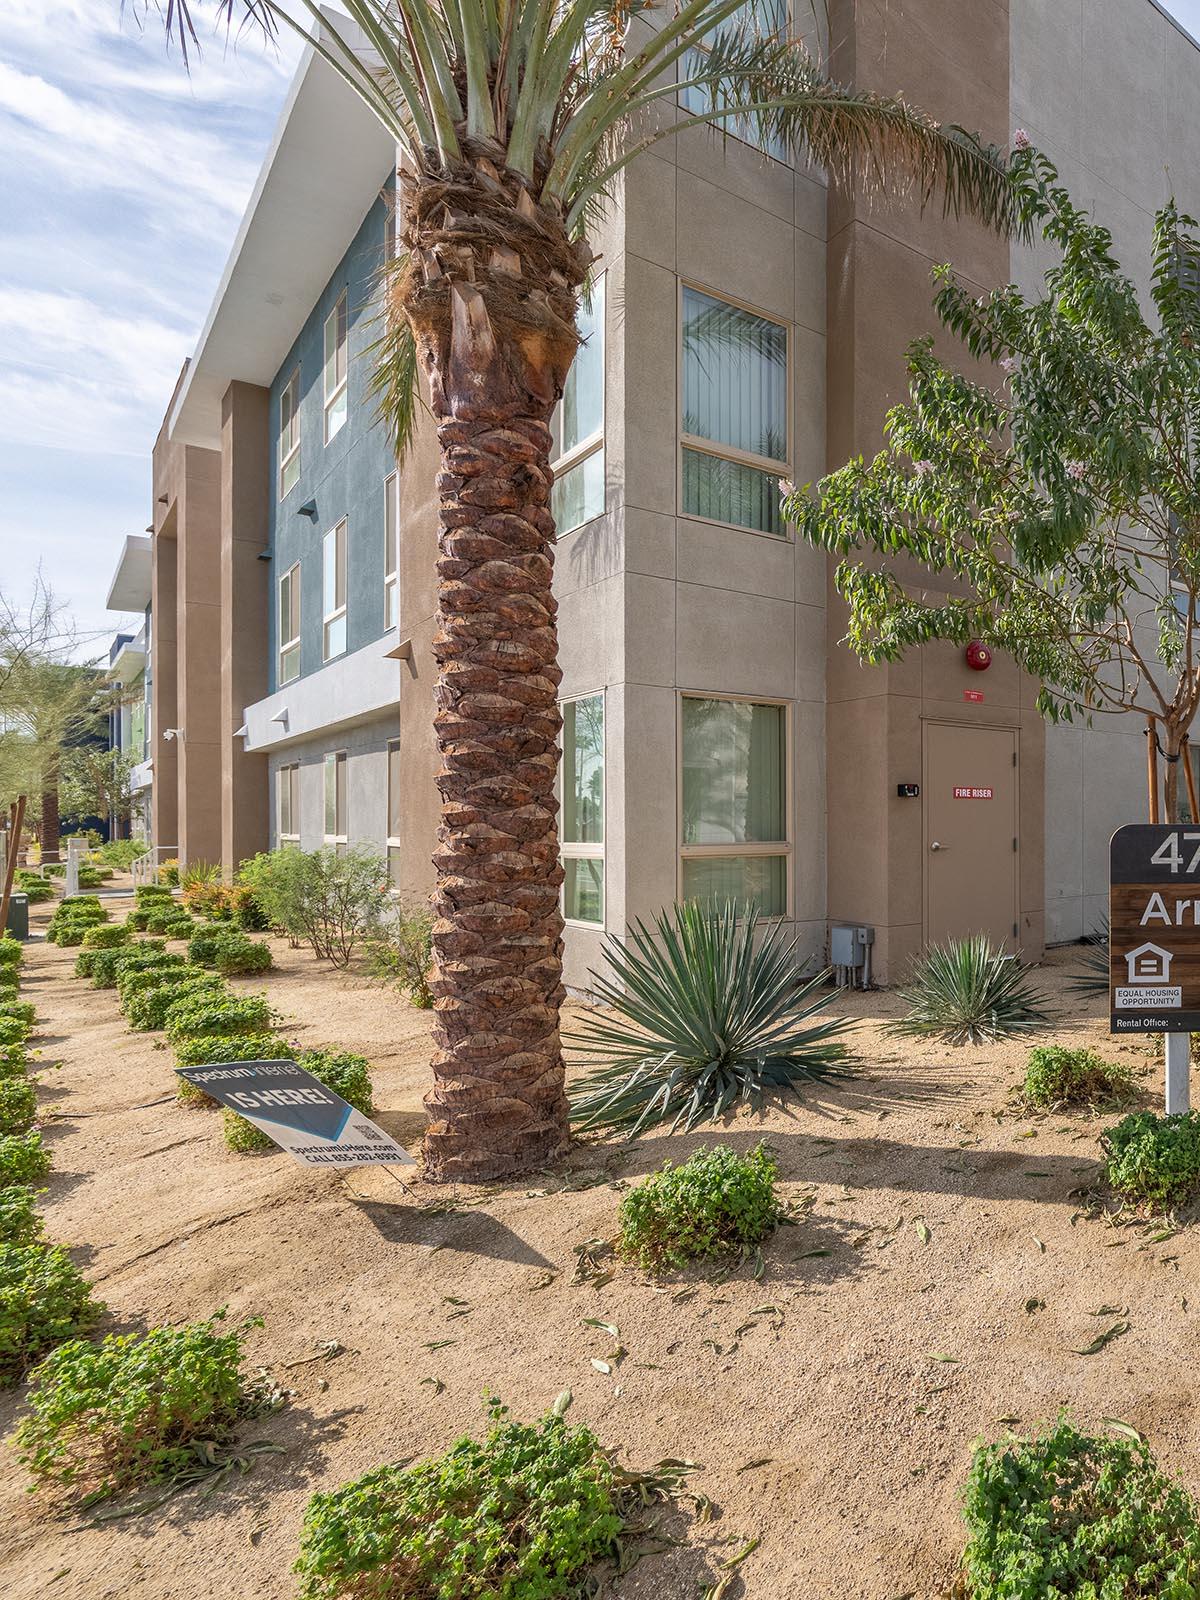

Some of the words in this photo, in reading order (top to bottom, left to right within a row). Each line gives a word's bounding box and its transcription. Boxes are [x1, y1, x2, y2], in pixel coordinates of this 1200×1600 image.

[955, 788, 971, 797] FIRE
[972, 789, 992, 798] RISER
[1117, 989, 1144, 998] EQUAL
[1145, 989, 1180, 998] HOUSING
[1121, 997, 1176, 1006] OPPORTUNITY
[1116, 1019, 1142, 1028] Rental
[1143, 1018, 1169, 1028] Office:
[182, 1068, 253, 1083] Spectrum
[225, 1092, 260, 1109] IS
[259, 1089, 334, 1107] HERE!
[289, 1144, 396, 1155] SpectrumIsHere.com
[305, 1154, 333, 1163] CALL
